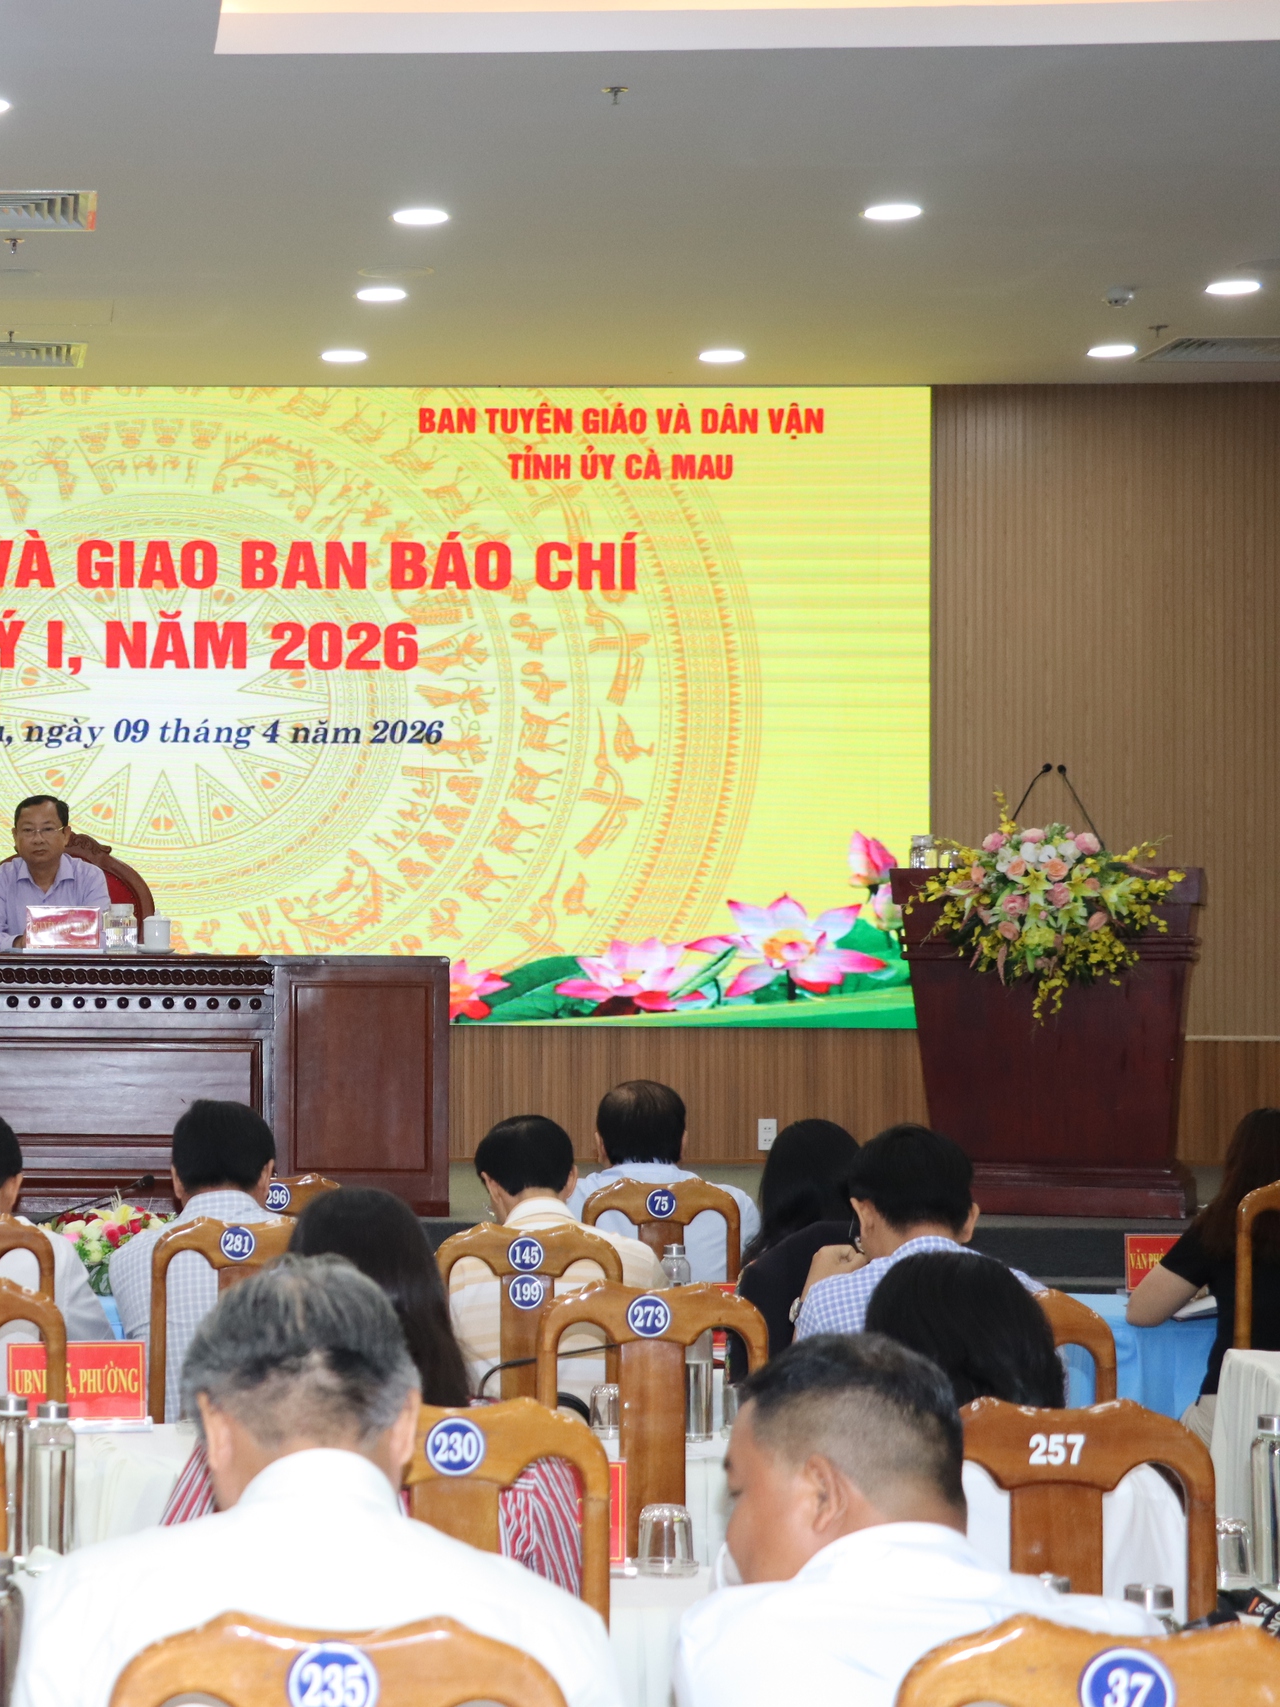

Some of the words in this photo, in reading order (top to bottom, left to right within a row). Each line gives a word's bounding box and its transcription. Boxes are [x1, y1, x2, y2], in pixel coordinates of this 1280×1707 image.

[418, 407, 477, 434] BAN
[485, 402, 573, 435] TUYÊN
[581, 402, 648, 435] GIÁO
[656, 402, 691, 435] VÀ
[701, 402, 759, 434] DÂN
[768, 403, 825, 440] VẬN
[508, 445, 571, 480] TỈNH
[580, 445, 616, 480] ỦY
[625, 448, 662, 481] CÀ
[671, 453, 734, 481] MAU
[77, 539, 218, 590] GIAO
[241, 540, 368, 590] BAN
[389, 531, 512, 591] BÁO
[535, 531, 638, 592] CHÍ
[47, 620, 82, 675] I,
[105, 610, 248, 669] NĂM
[270, 621, 419, 671] 2026
[25, 718, 105, 750] ngày
[114, 718, 149, 743] 09
[159, 718, 255, 750] tháng
[262, 719, 281, 744] 4
[291, 720, 361, 744] năm
[369, 719, 444, 745] 2026
[266, 1189, 287, 1205] 296
[653, 1195, 669, 1212] 75
[224, 1233, 250, 1253] 281
[514, 1245, 540, 1265] 145
[1129, 1247, 1147, 1270] VĂN
[514, 1282, 540, 1302] 199
[633, 1305, 666, 1328] 273
[14, 1368, 48, 1395] UBN
[79, 1361, 139, 1395] PHƯỜNG
[433, 1430, 477, 1463] 230
[1028, 1433, 1087, 1466] 257
[300, 1662, 368, 1707] 235
[1103, 1667, 1155, 1707] 37
